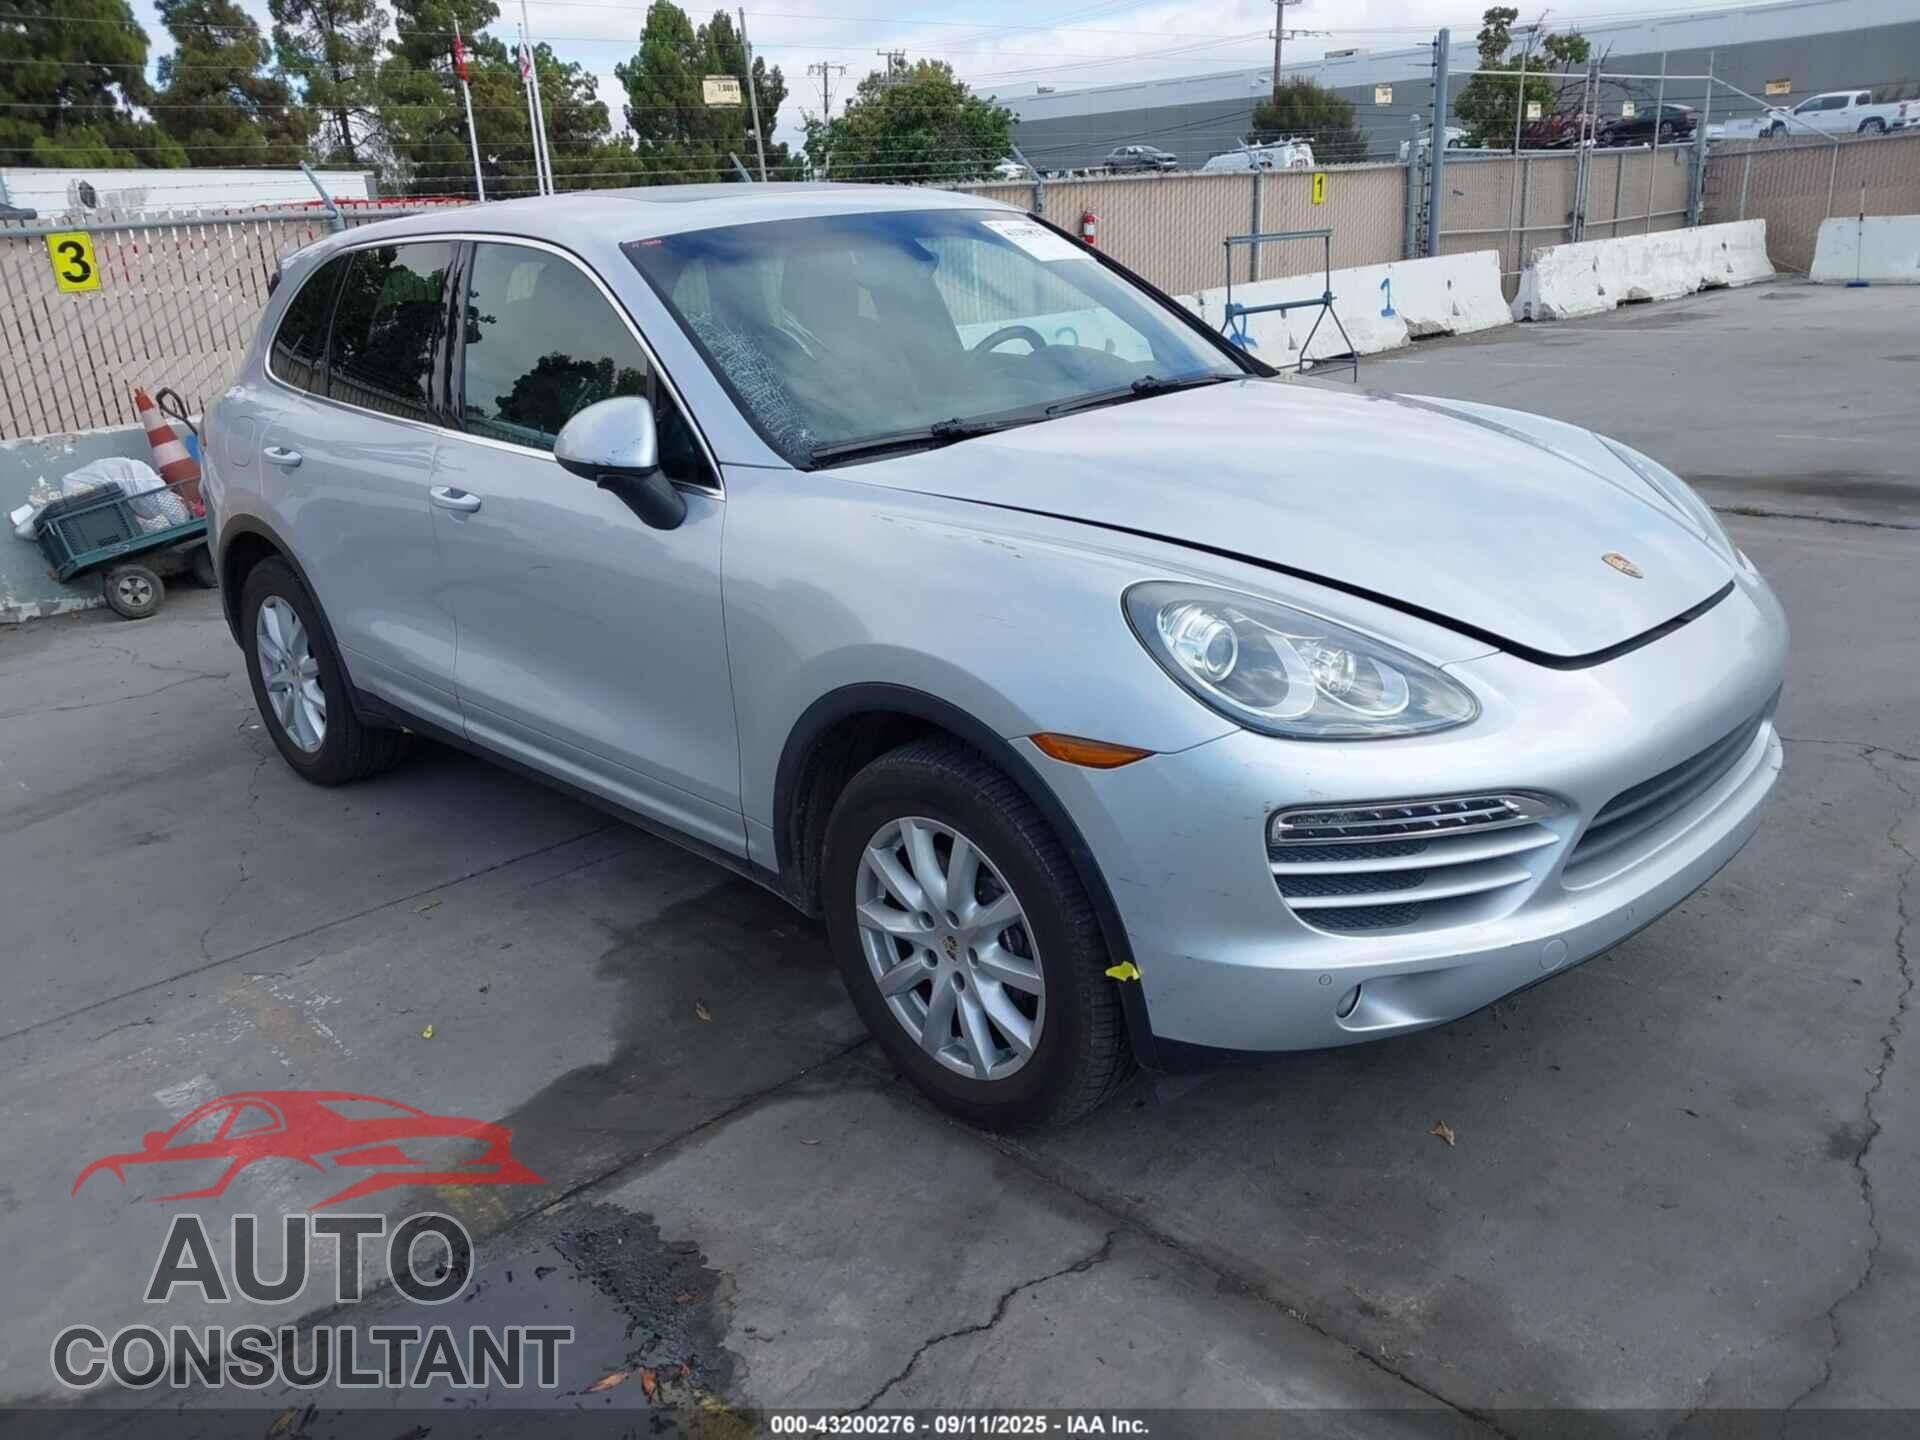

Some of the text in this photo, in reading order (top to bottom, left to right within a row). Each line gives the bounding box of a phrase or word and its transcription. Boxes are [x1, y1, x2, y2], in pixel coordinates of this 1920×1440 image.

[1316, 175, 1323, 199] 1
[58, 241, 91, 283] 3
[1380, 277, 1395, 317] 1
